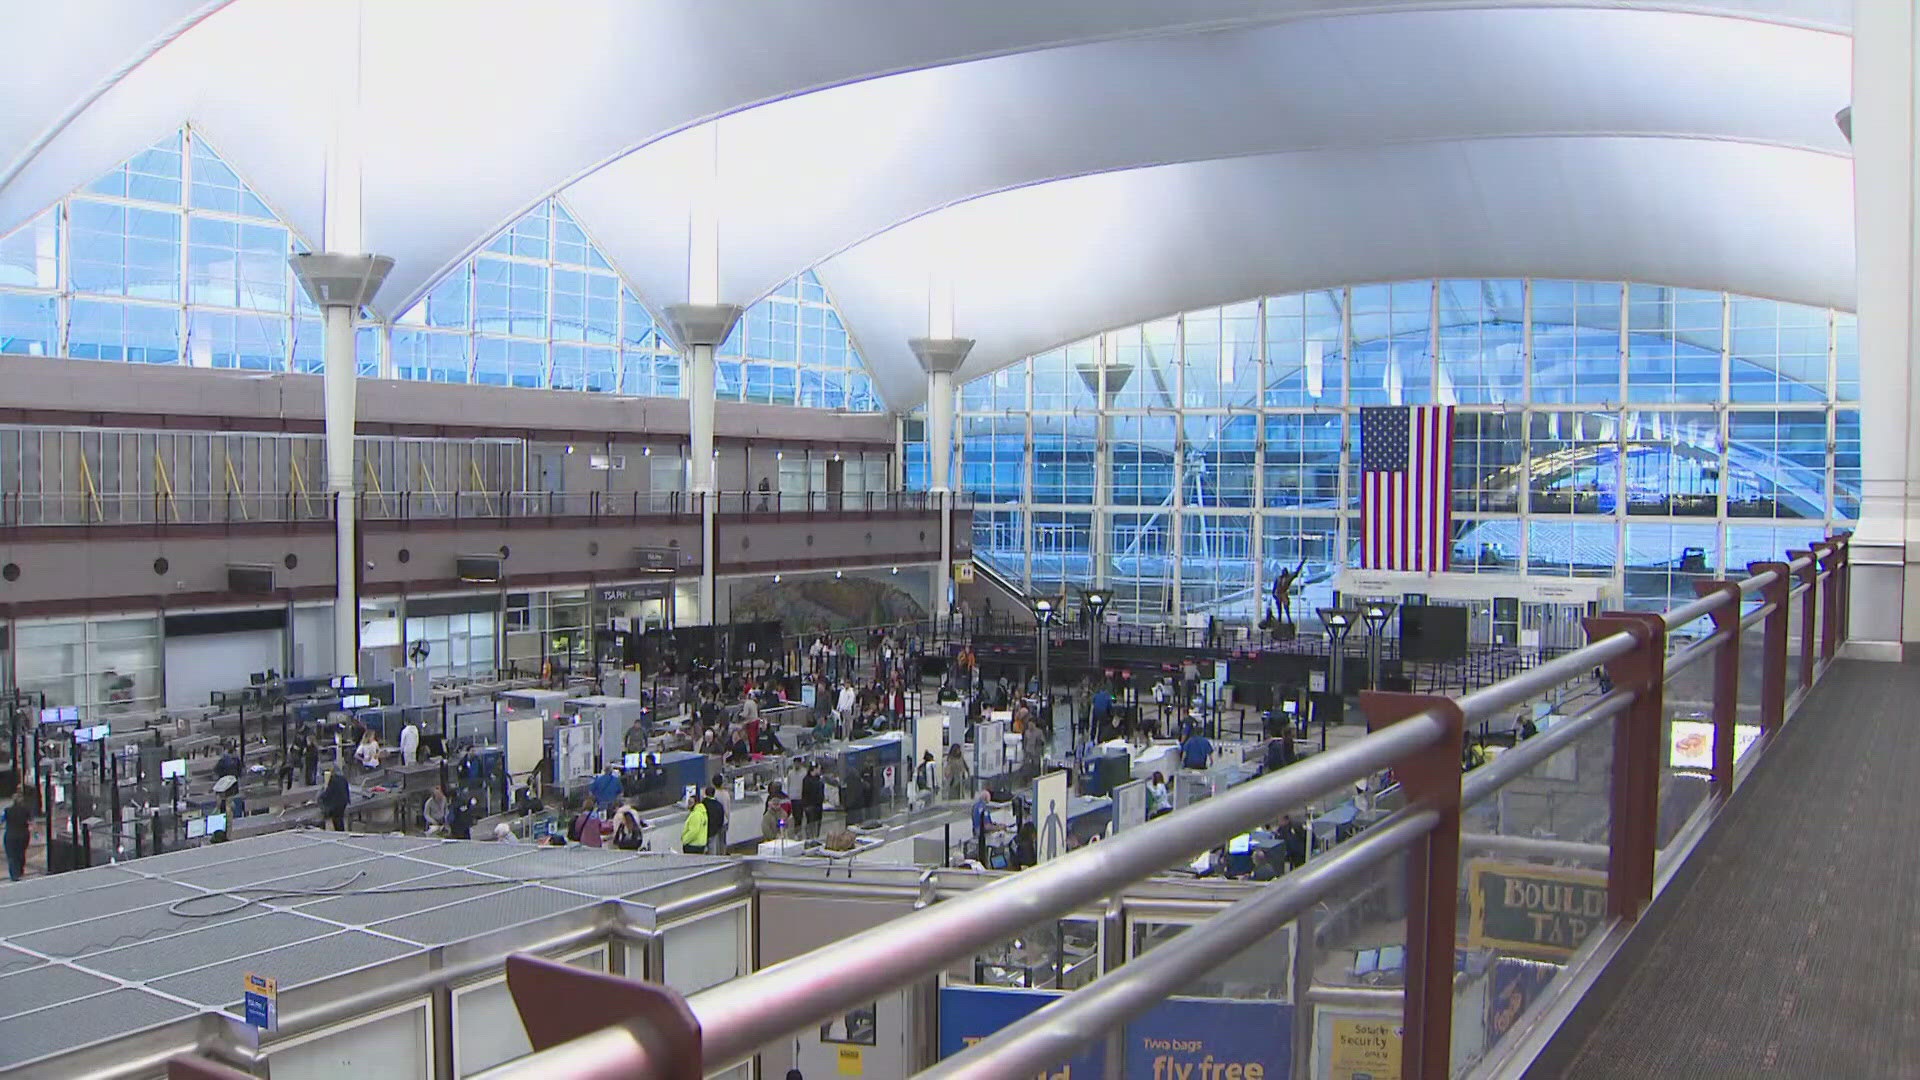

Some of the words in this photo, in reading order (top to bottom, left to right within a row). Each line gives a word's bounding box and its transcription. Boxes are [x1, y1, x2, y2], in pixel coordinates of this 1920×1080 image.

[1504, 879, 1608, 916] BOULD
[1144, 1038, 1171, 1050] Two
[1172, 1039, 1202, 1052] bags
[1341, 1035, 1387, 1049] Security
[1153, 1055, 1193, 1080] fly
[1199, 1055, 1264, 1080] free
